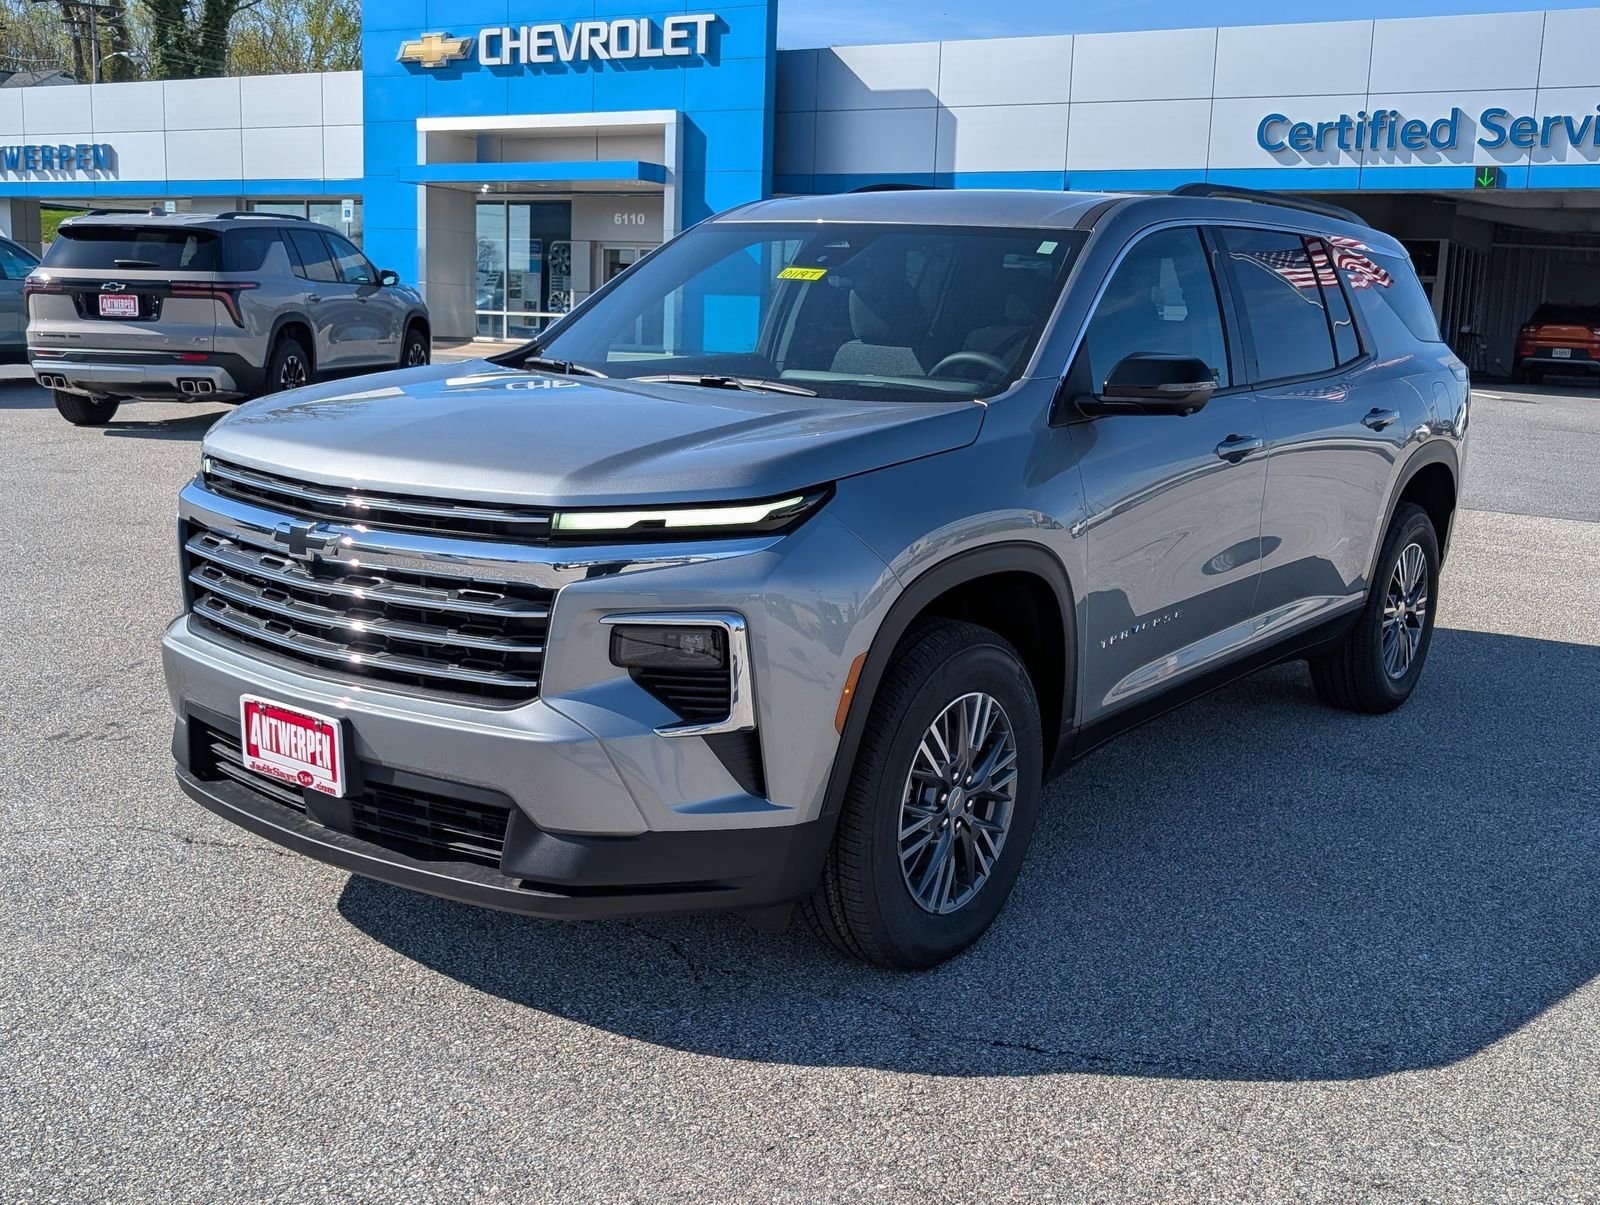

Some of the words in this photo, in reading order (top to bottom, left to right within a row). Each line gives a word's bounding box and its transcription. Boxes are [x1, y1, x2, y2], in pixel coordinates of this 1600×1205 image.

[478, 13, 716, 66] CHEVROLET
[1257, 107, 1460, 152] Certified
[0, 144, 112, 171] WERPEN
[613, 212, 646, 225] 6110
[250, 711, 333, 770] ANTWERPEN
